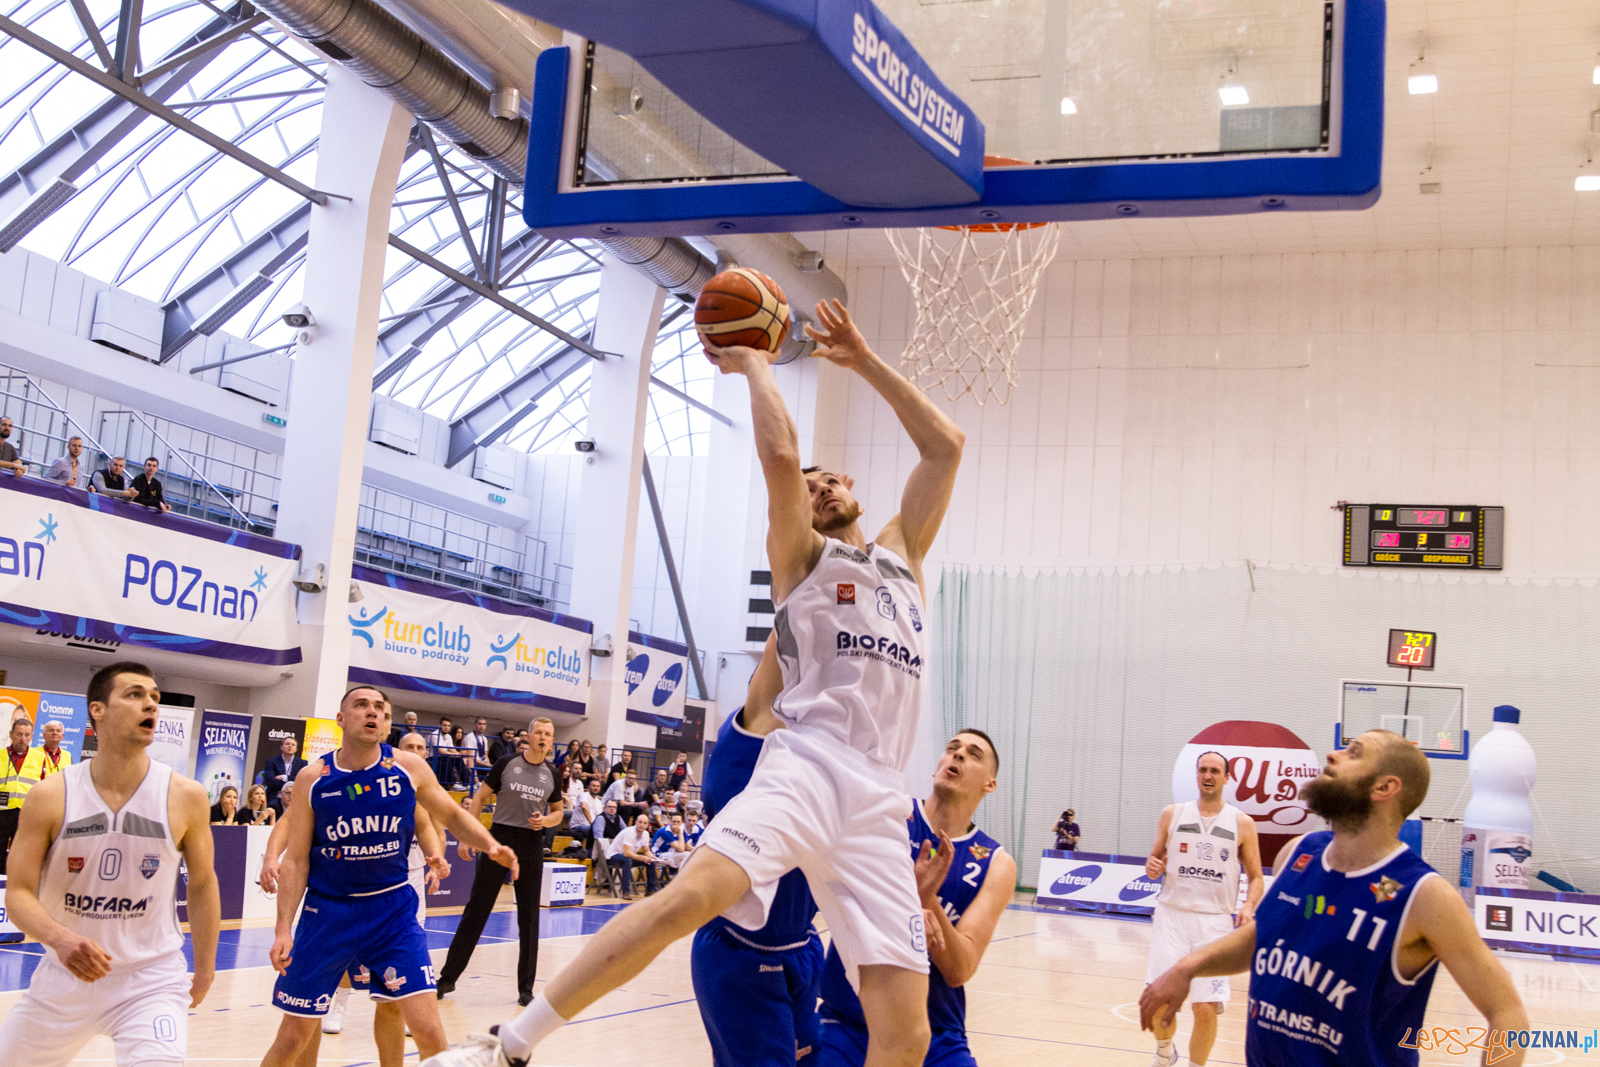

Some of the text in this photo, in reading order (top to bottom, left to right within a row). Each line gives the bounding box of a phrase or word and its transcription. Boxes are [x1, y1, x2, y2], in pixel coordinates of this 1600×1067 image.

[853, 12, 964, 146] SPORT SYSTEM
[1381, 509, 1391, 521] 0
[1379, 533, 1400, 547] 28
[1418, 533, 1428, 545] 3
[1448, 534, 1470, 548] 34
[1422, 554, 1469, 564] GOSPODARZE
[875, 586, 897, 621] 8
[383, 610, 471, 653] funclub
[384, 640, 417, 656] biuro
[421, 648, 470, 666] podróży
[515, 636, 582, 674] funclub
[836, 630, 923, 672] BIOFARM
[1397, 645, 1425, 665] 20
[836, 649, 863, 658] POLSKI
[863, 651, 902, 671] PRODUCENT
[543, 668, 581, 686] podróży
[203, 727, 247, 751] SELENKA
[376, 775, 402, 798] 15
[509, 782, 545, 798] VERONI
[66, 824, 105, 835] macron
[325, 815, 402, 842] GÓRNIK
[341, 840, 400, 856] TRANS.EU
[721, 825, 762, 855] macron
[1195, 841, 1214, 861] 12
[98, 848, 123, 881] 0
[1178, 865, 1223, 880] BIOFARM
[962, 862, 982, 888] 2
[1057, 873, 1093, 886] atrem
[1126, 880, 1162, 893] atrem
[64, 892, 147, 912] BIOFARM
[81, 912, 122, 920] PRODUCENT
[1526, 910, 1598, 938] NICK
[1346, 907, 1387, 951] 11
[1255, 938, 1357, 1011] GÓRNIK
[277, 990, 312, 1008] RONAL
[1258, 1000, 1344, 1046] TRANS.EU
